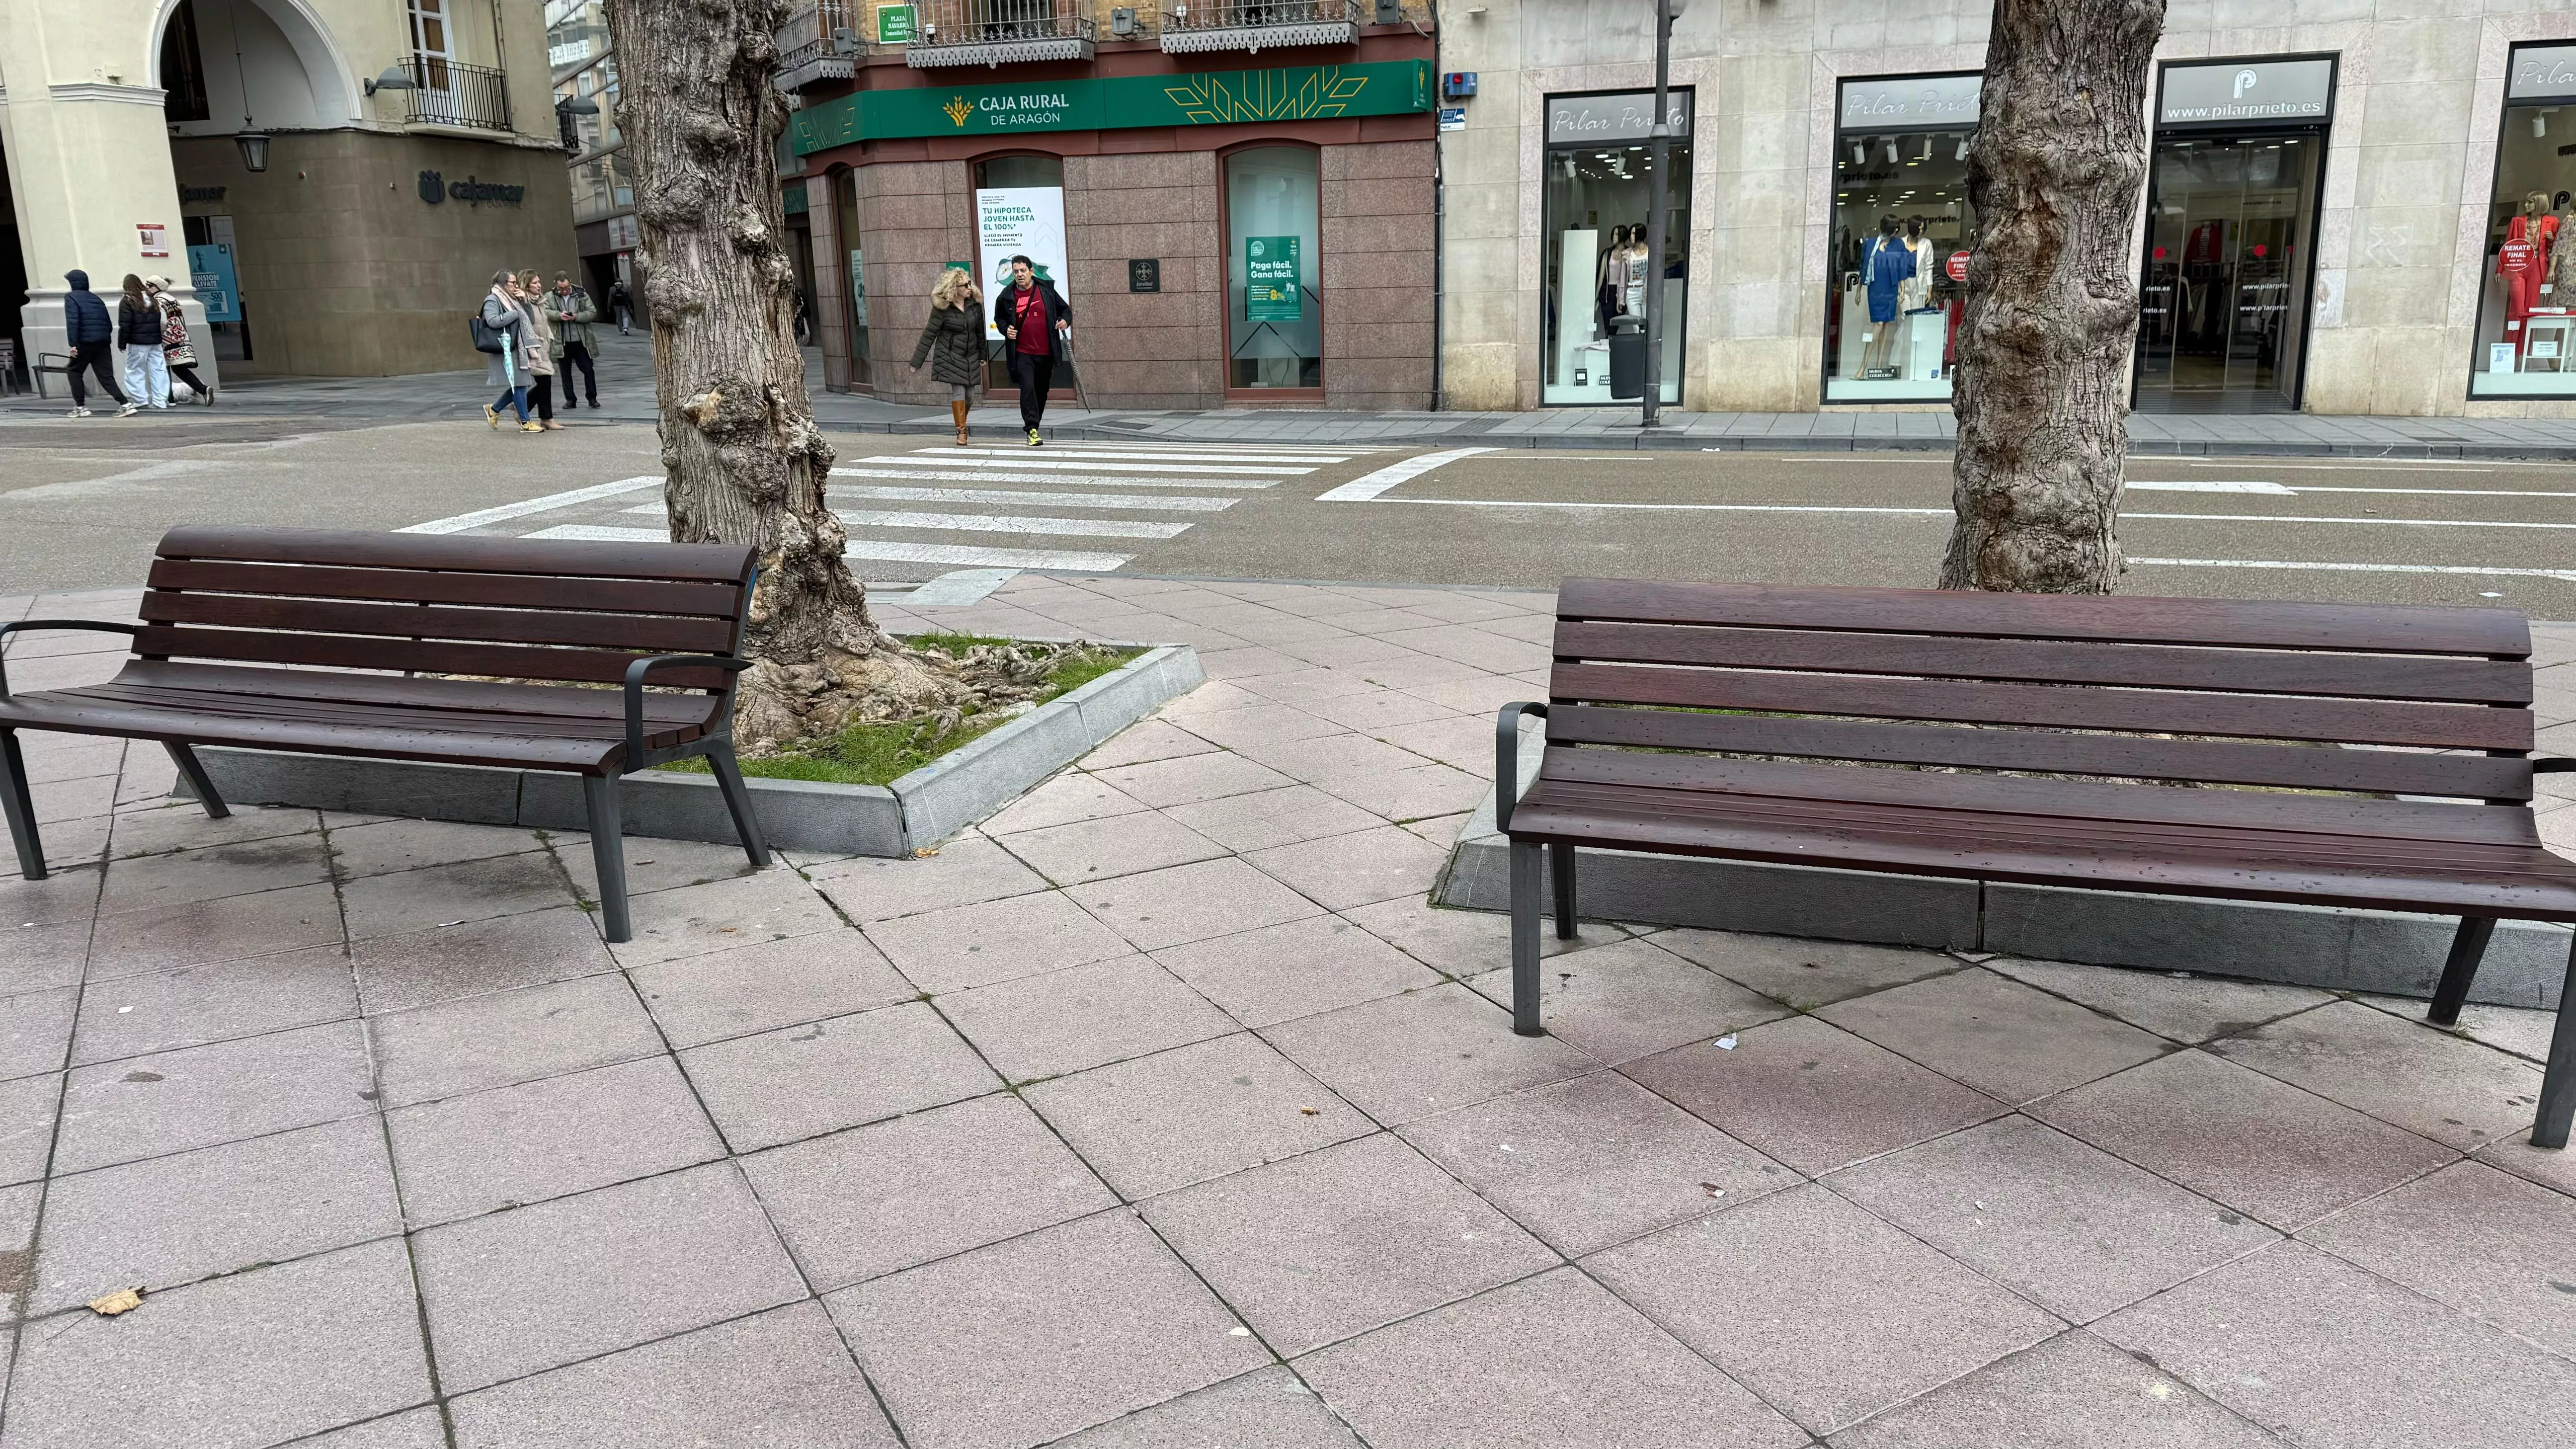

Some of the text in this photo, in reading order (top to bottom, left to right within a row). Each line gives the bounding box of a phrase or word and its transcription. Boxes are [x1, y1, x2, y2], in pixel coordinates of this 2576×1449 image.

[2518, 60, 2576, 85] Pila
[980, 94, 1069, 111] CAJA RURAL
[1847, 90, 1980, 116] Pilar Priet
[2167, 100, 2321, 119] www.pilarprieto.es
[991, 111, 1060, 125] DE ARAGÓN
[1554, 106, 1684, 132] Pilar Prito
[1839, 171, 1899, 183] prieto.es
[449, 175, 524, 207] cajamar
[1251, 260, 1292, 271] Paga fácil.
[1251, 270, 1294, 278] Gana fácil.
